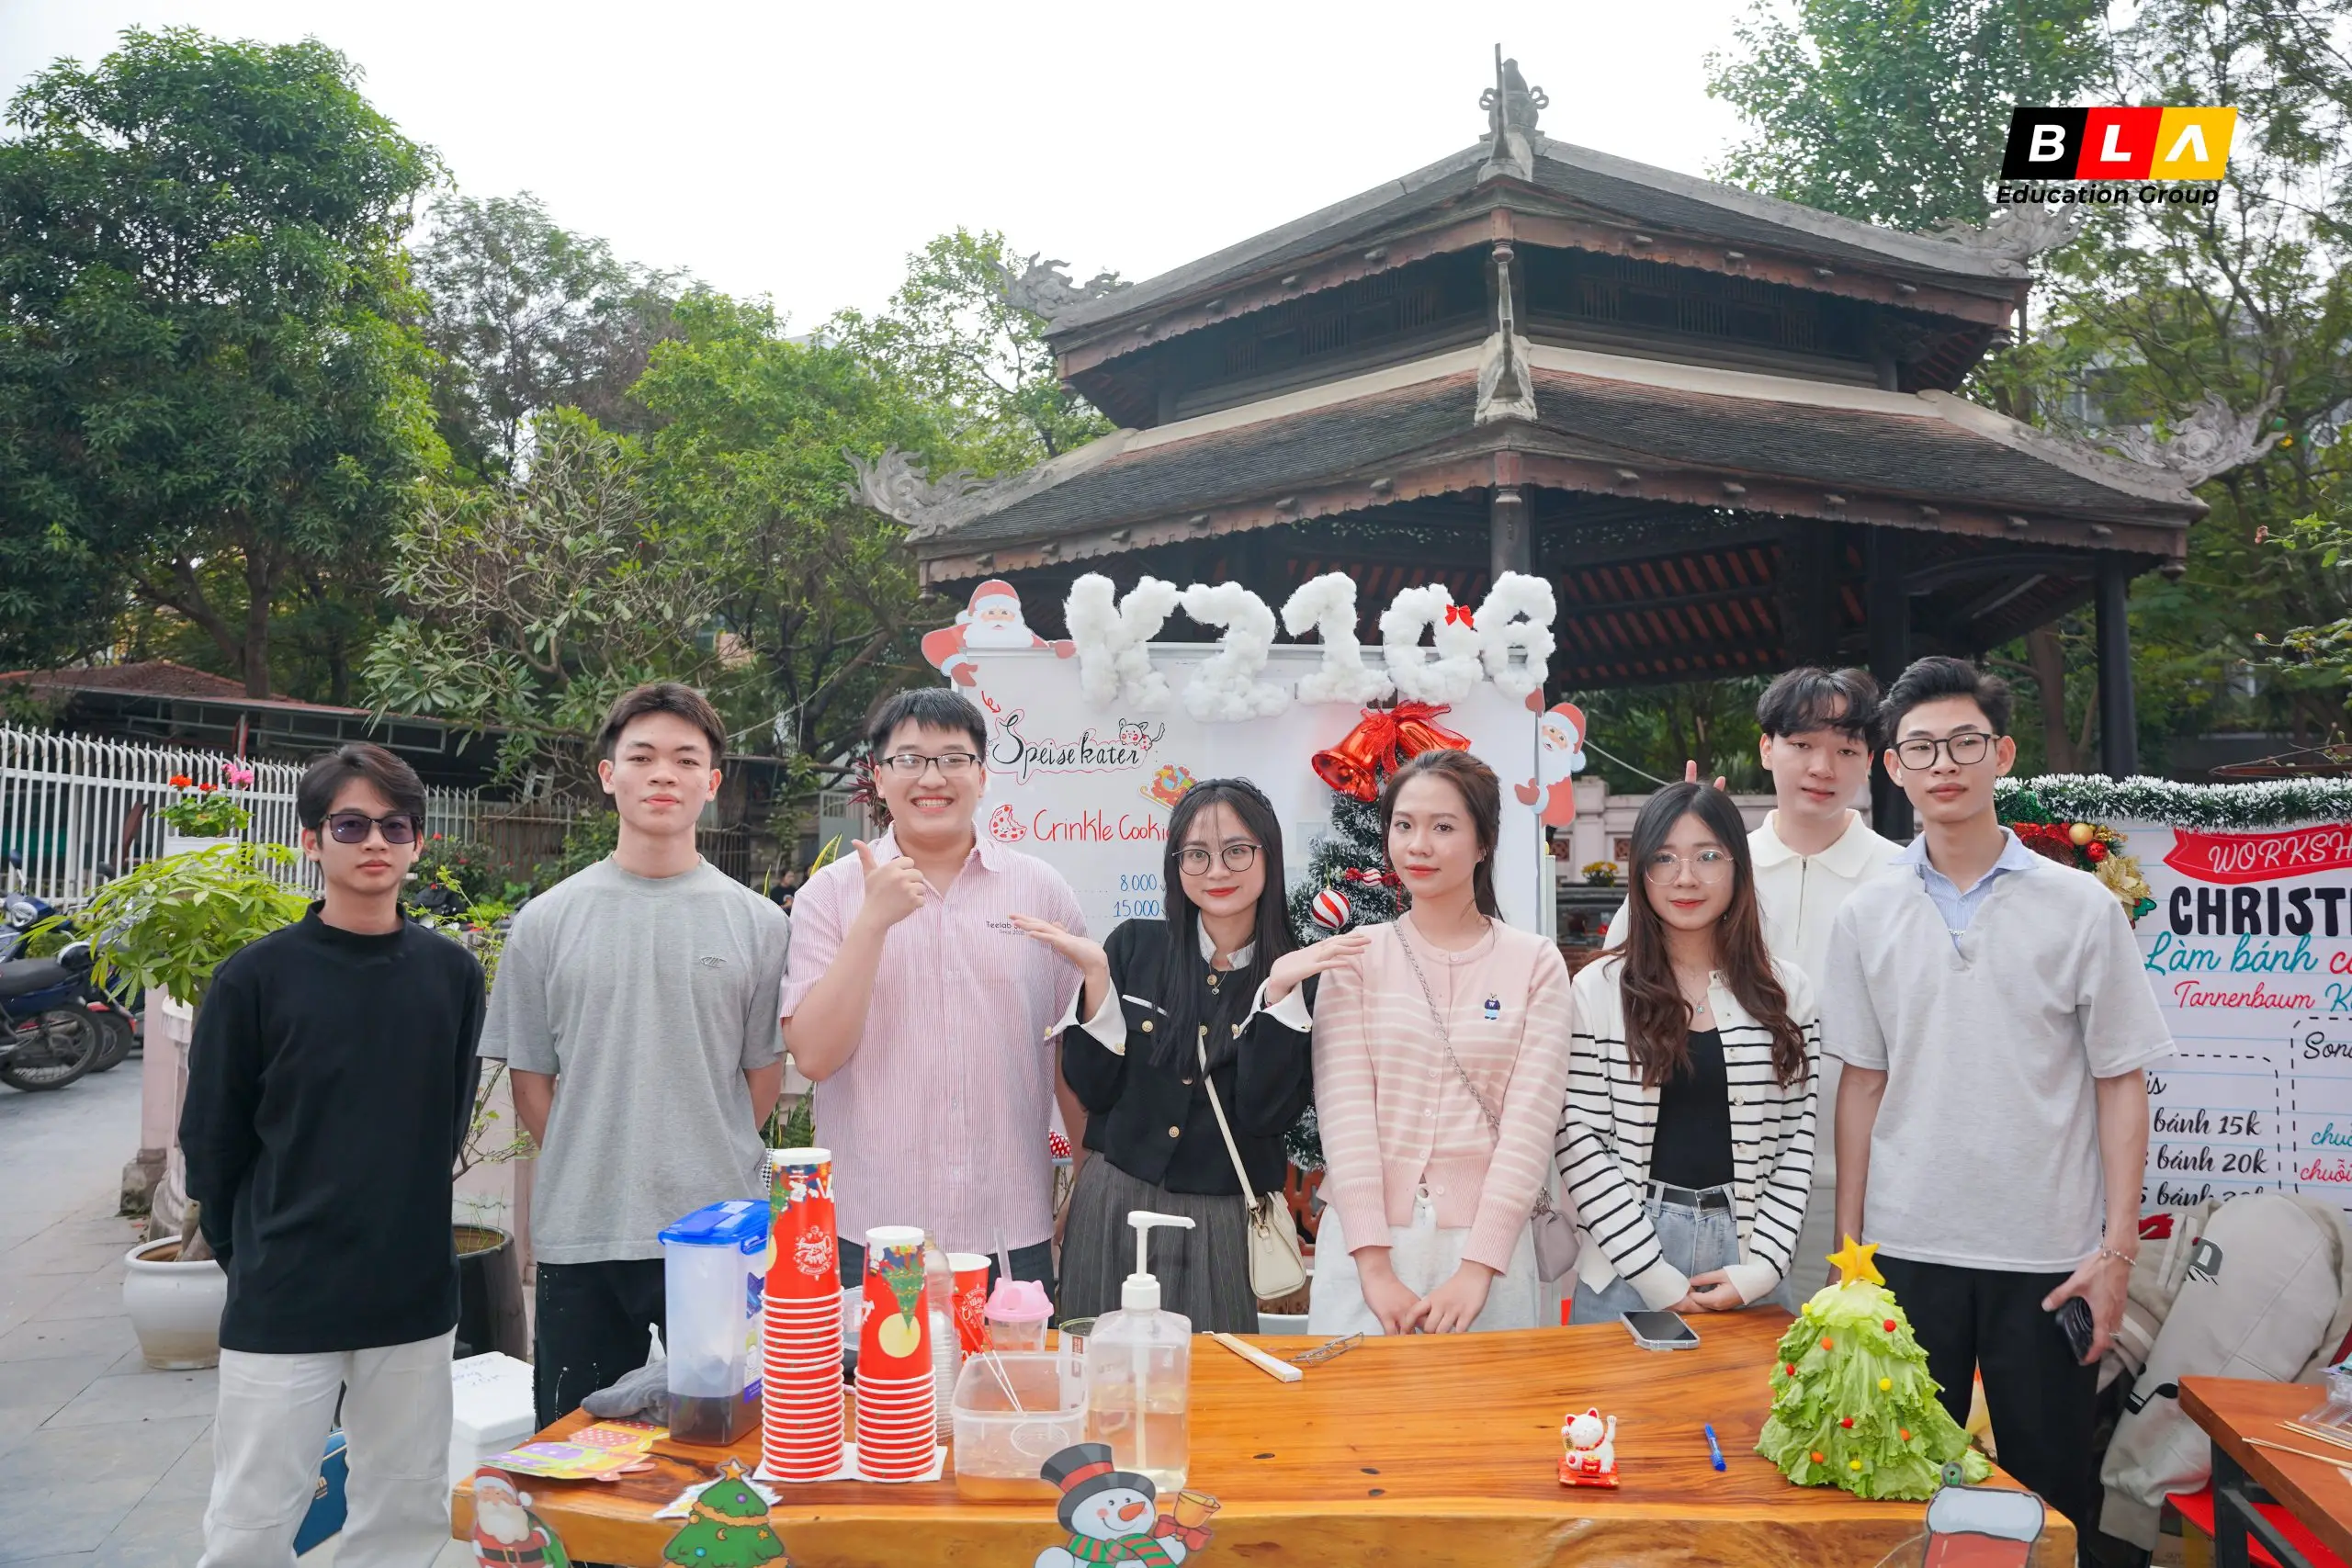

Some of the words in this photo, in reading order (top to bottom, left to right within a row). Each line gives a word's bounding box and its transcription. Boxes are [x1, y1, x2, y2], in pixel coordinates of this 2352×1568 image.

[1034, 809, 1114, 841] Crinkle
[2169, 886, 2352, 937] CHRIST
[2144, 931, 2222, 976] Làm
[2230, 932, 2318, 974] bánh
[2174, 980, 2315, 1010] Tannenbaum
[2154, 1107, 2211, 1135] bánh
[2217, 1110, 2262, 1136] 15k
[2157, 1145, 2215, 1173] bánh
[2222, 1148, 2268, 1175] 20k
